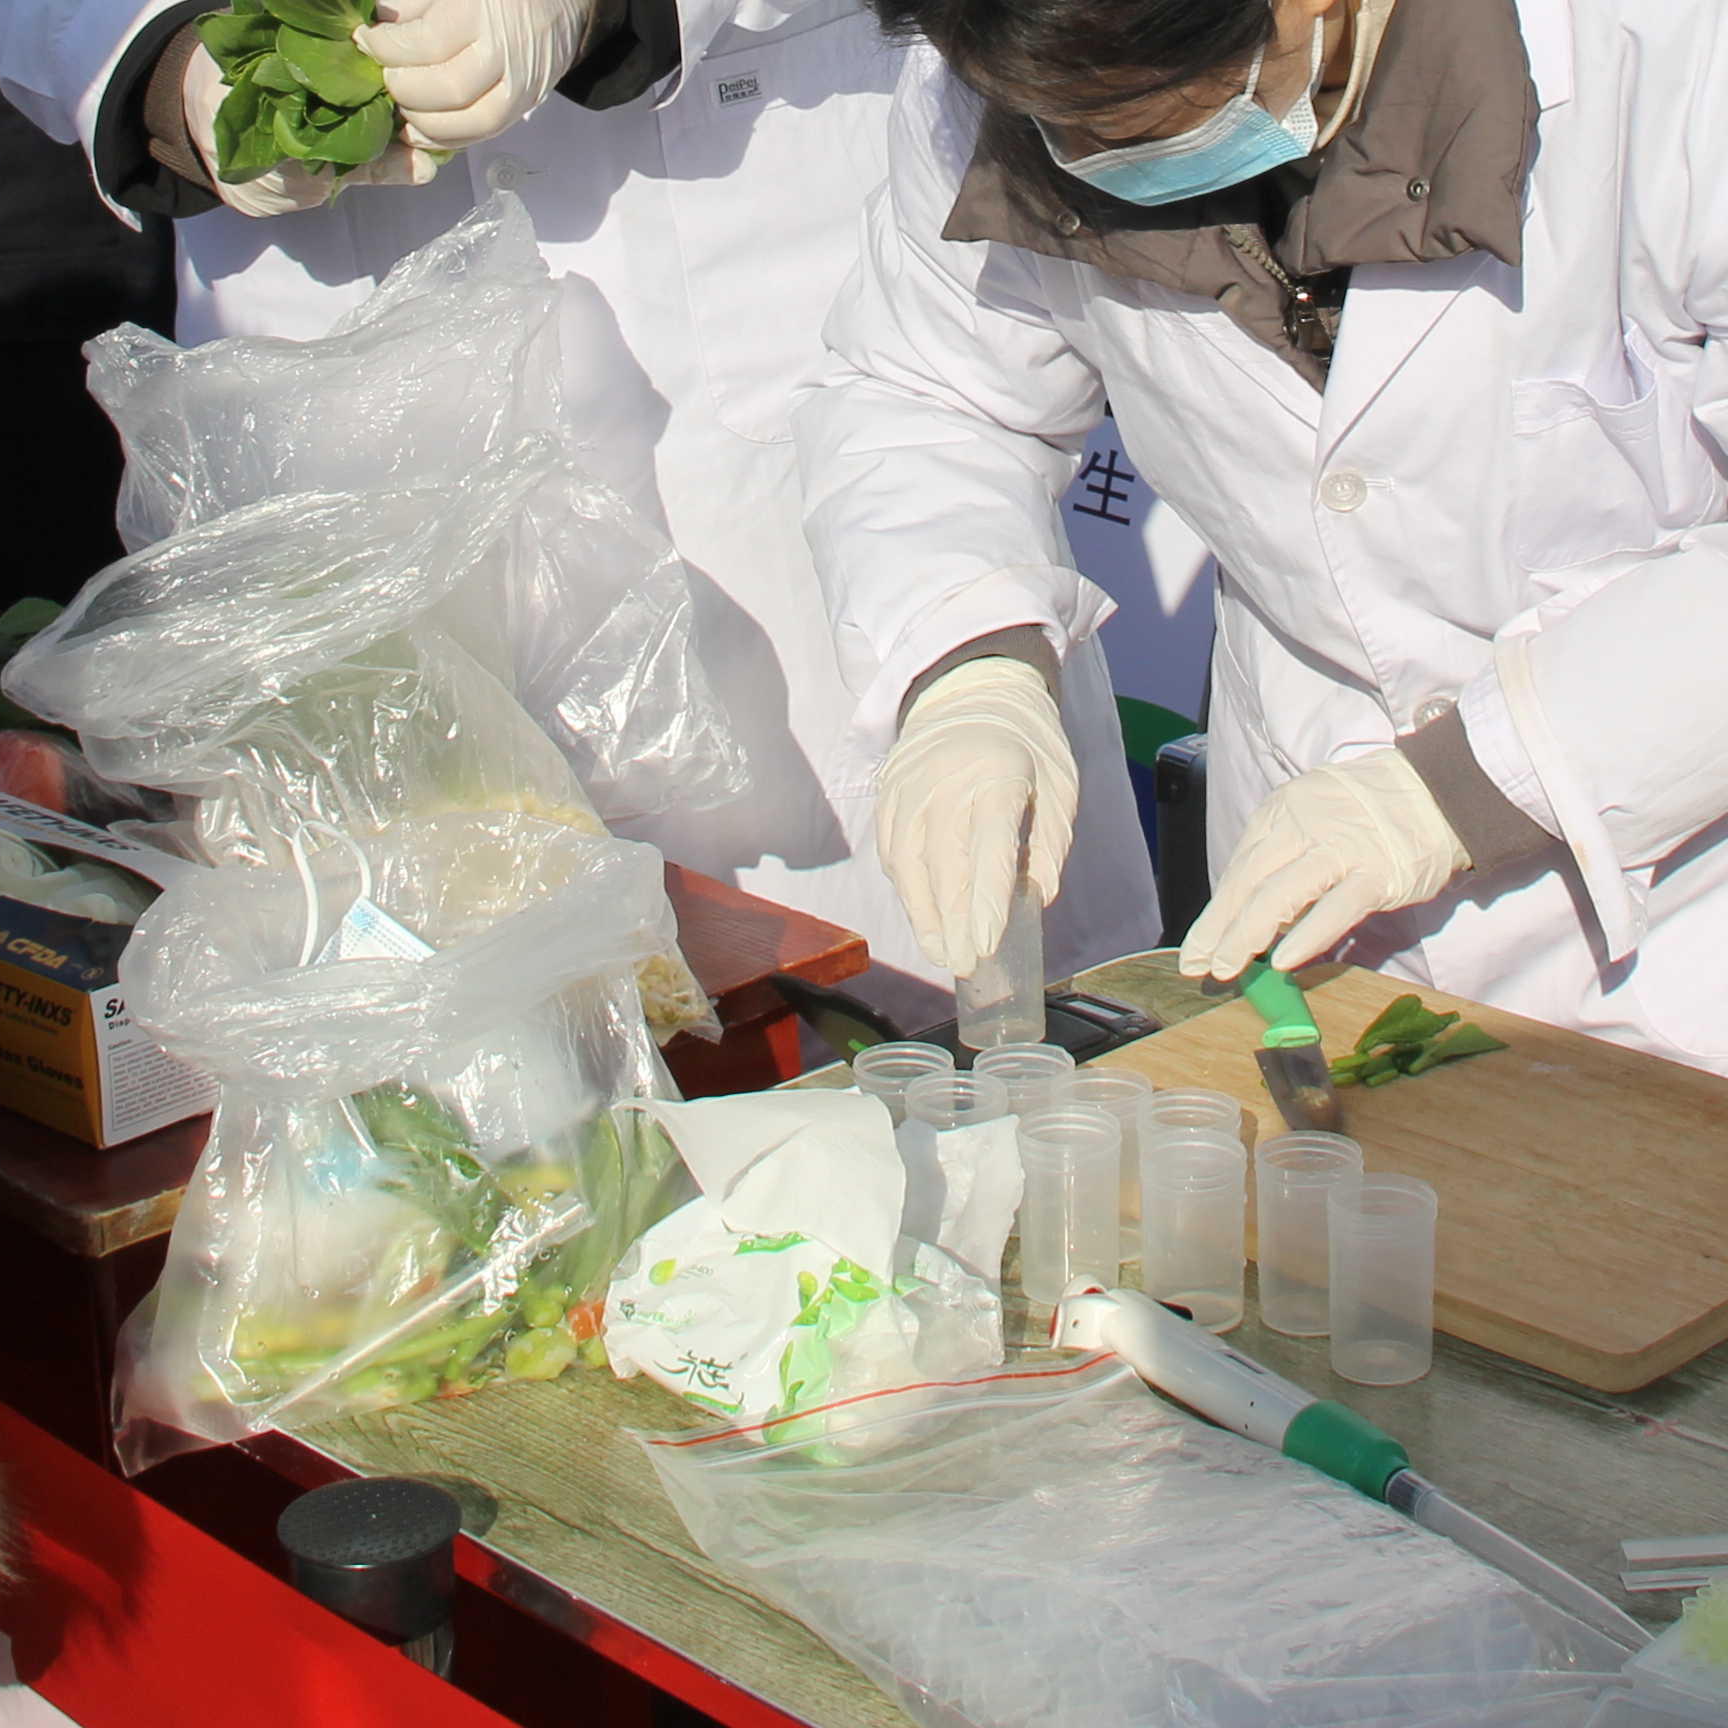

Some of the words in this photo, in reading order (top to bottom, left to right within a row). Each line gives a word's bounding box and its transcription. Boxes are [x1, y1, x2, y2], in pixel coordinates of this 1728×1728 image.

[1073, 449, 1135, 526] 生
[6, 938, 70, 970] CFDA
[26, 1054, 84, 1090] Gloves
